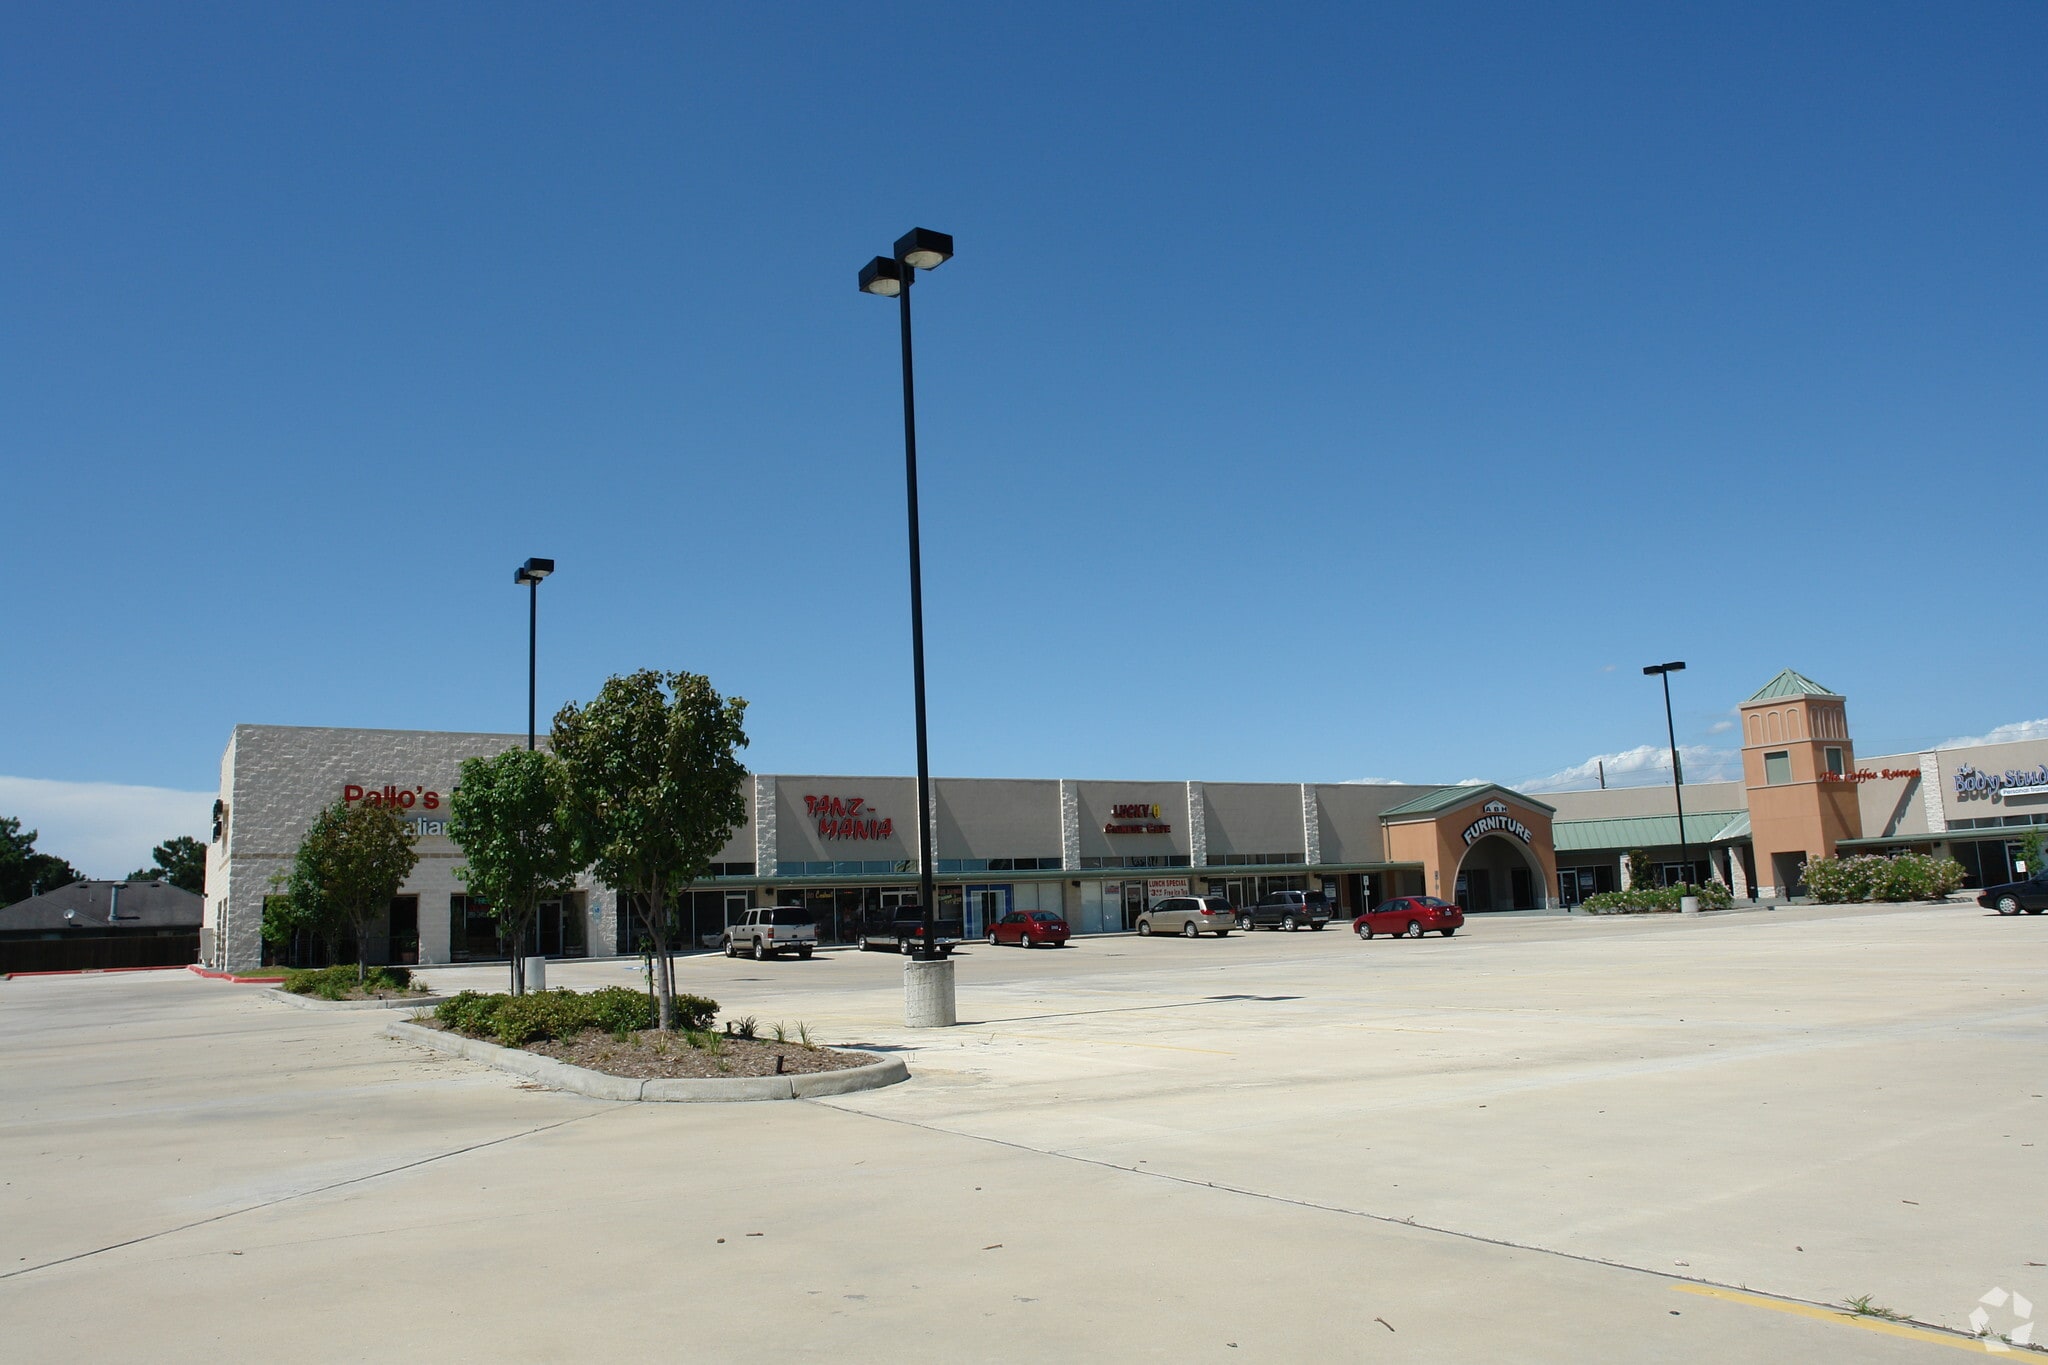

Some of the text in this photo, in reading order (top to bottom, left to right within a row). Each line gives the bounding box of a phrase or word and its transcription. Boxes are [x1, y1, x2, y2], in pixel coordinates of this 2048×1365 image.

[1844, 768, 1878, 783] Coffee
[1953, 764, 2048, 795] Body Stud
[1111, 804, 1149, 818] LUCKY
[819, 818, 892, 840] MANIA
[1463, 815, 1532, 845] FURNITURE
[1166, 879, 1187, 887] SPECIAL
